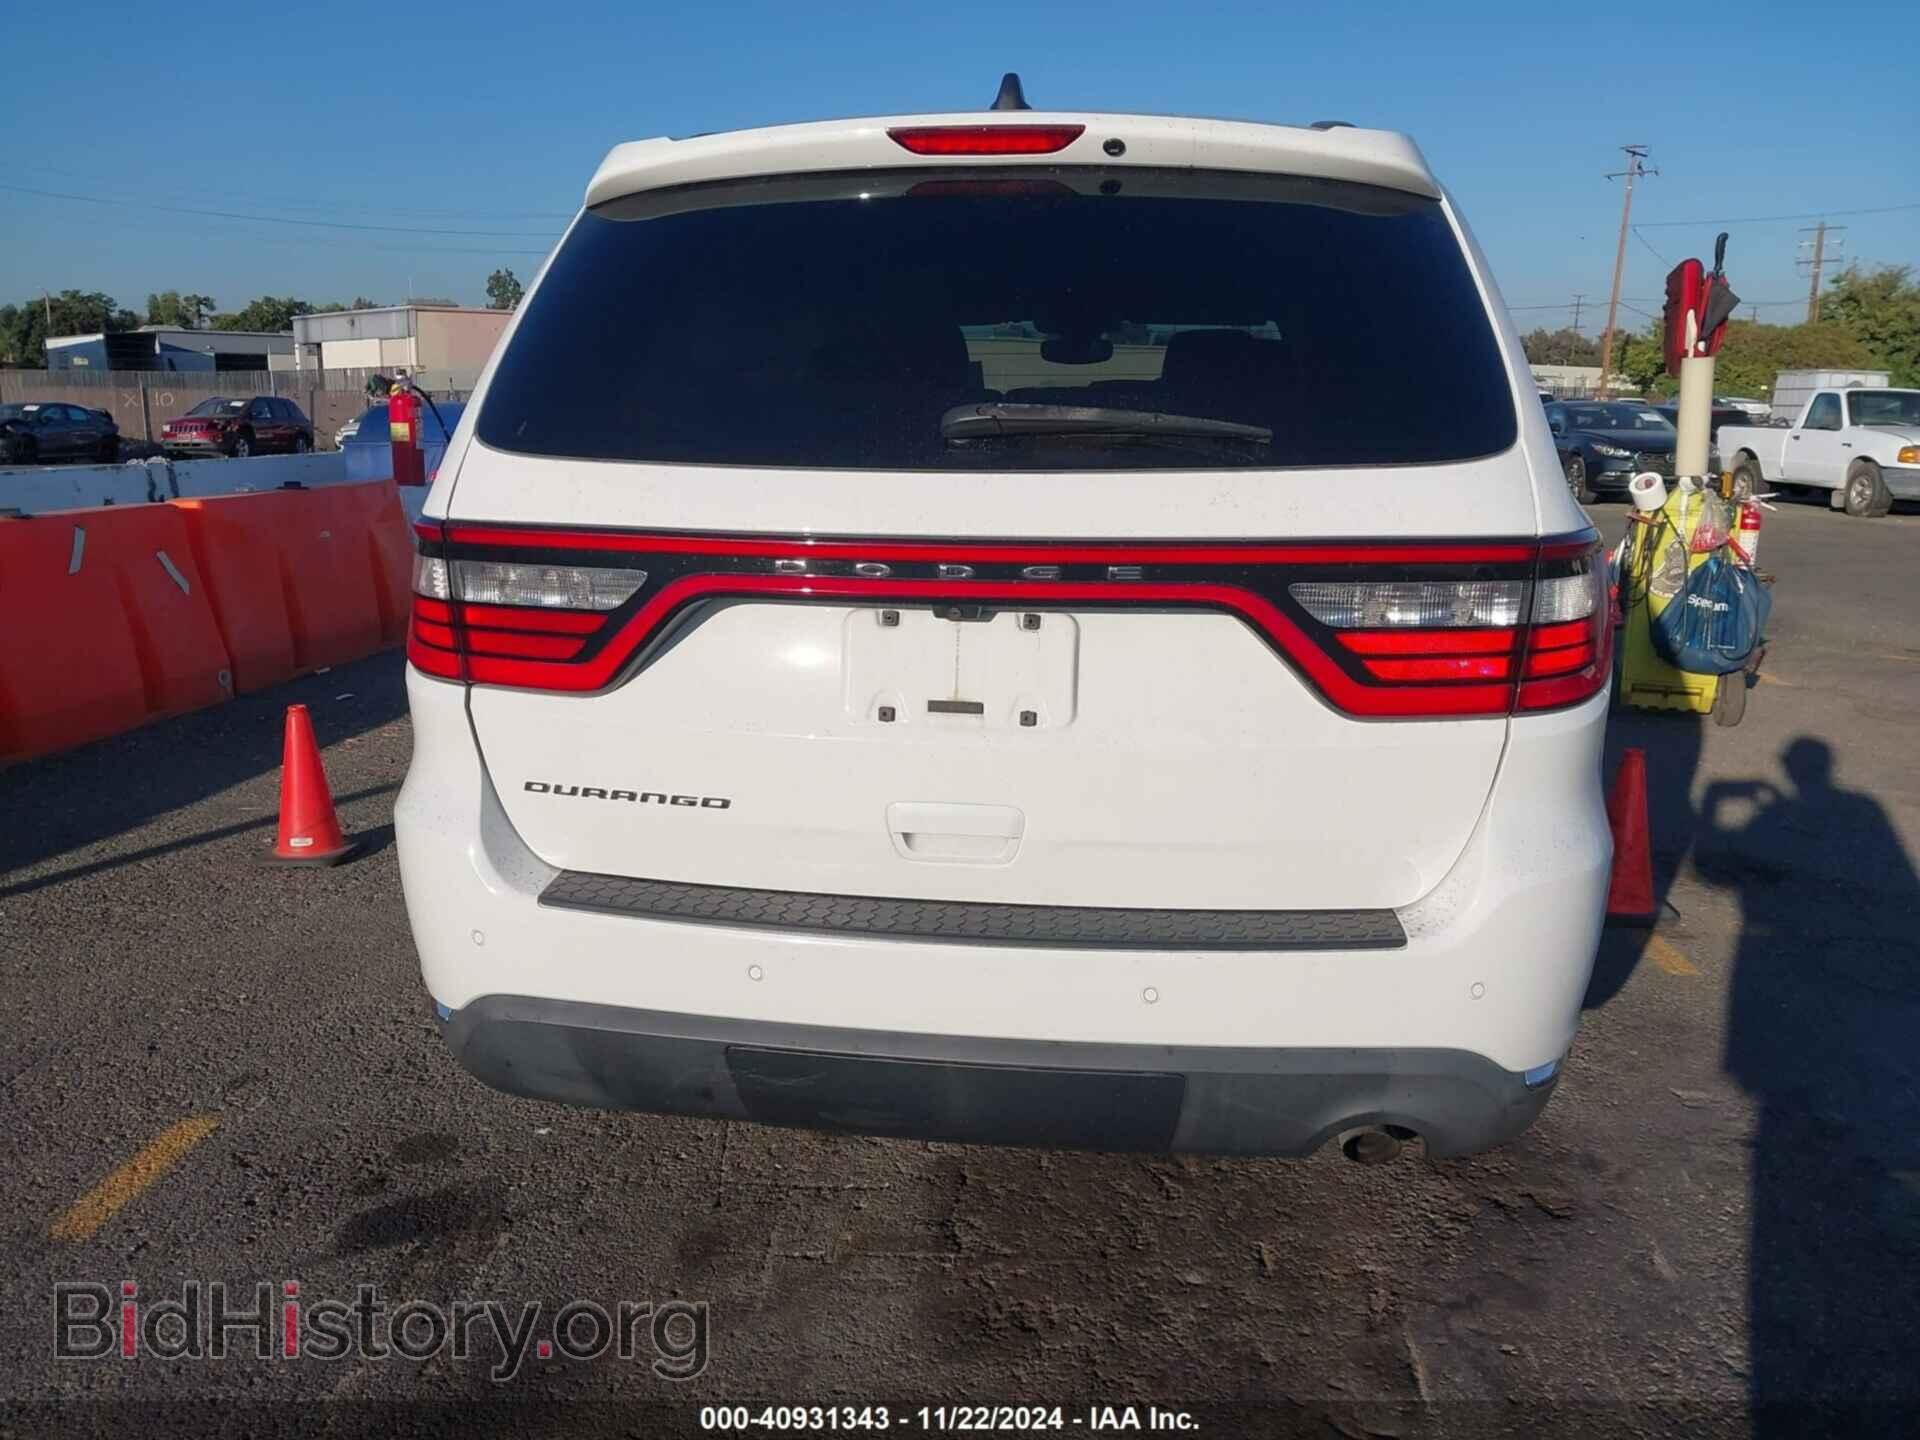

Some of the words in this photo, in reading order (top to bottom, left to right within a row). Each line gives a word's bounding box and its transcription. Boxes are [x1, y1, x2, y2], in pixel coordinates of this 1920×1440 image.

[775, 559, 1142, 581] DODGE
[1687, 594, 1728, 612] Specum
[524, 781, 731, 809] DURANGO
